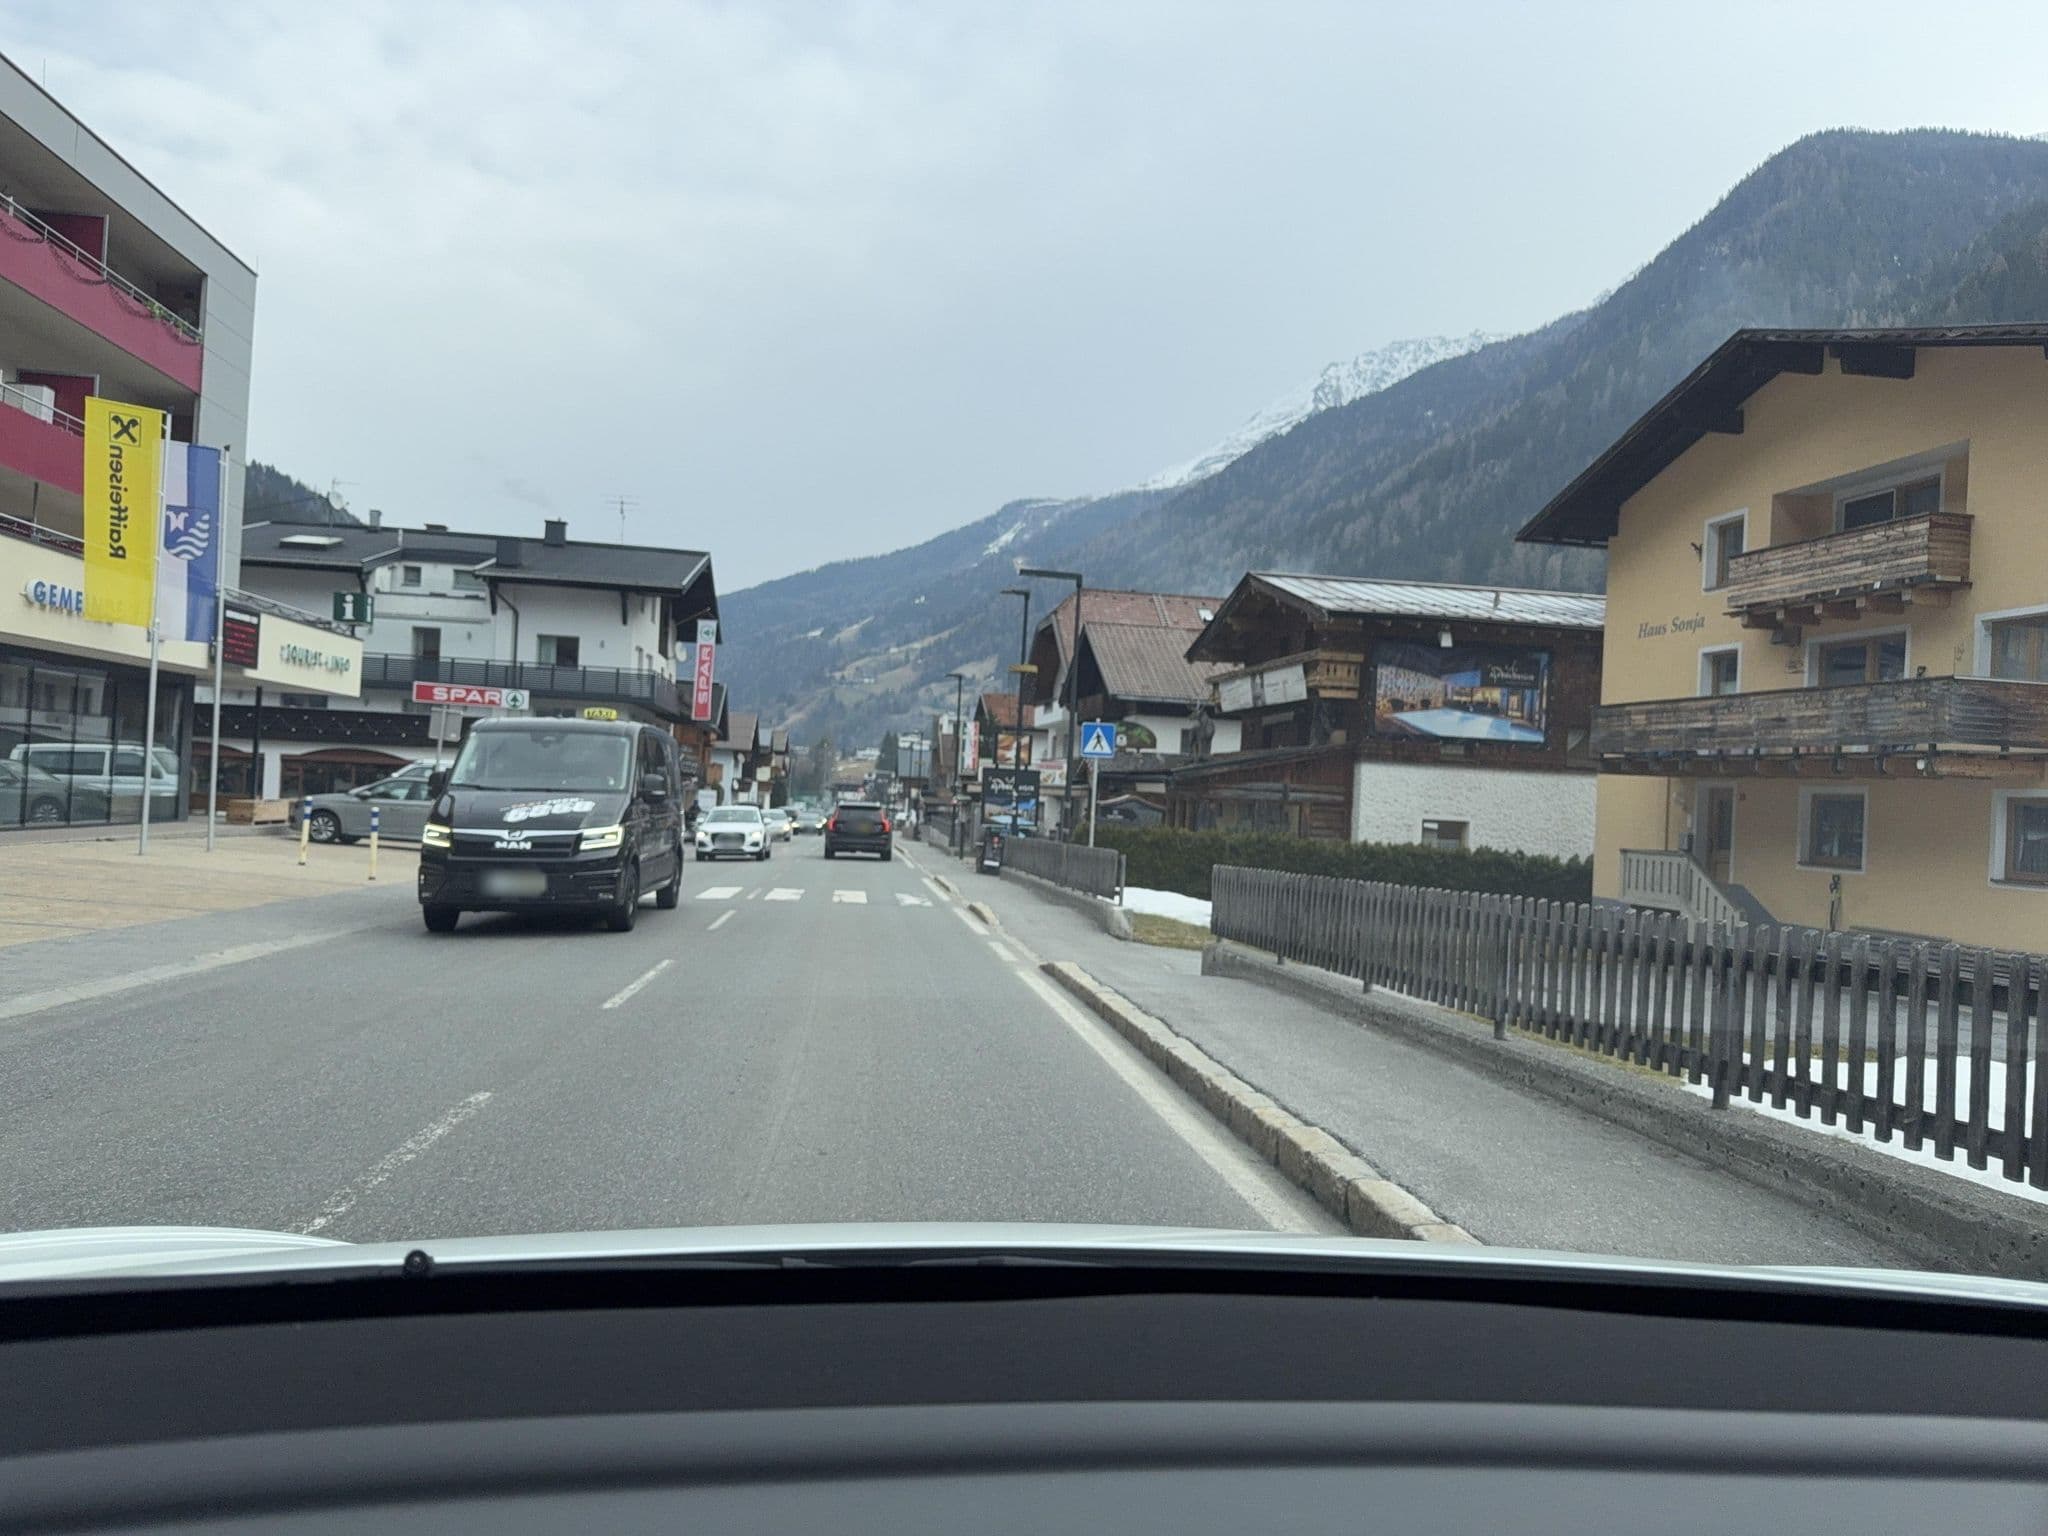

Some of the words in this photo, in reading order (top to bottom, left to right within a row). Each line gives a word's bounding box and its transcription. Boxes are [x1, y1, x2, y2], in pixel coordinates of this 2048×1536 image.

[1638, 622, 1667, 639] Haus
[1671, 612, 1706, 634] Sonja
[697, 646, 712, 704] SPAR
[432, 687, 501, 704] SPAR
[494, 840, 532, 851] MAN
